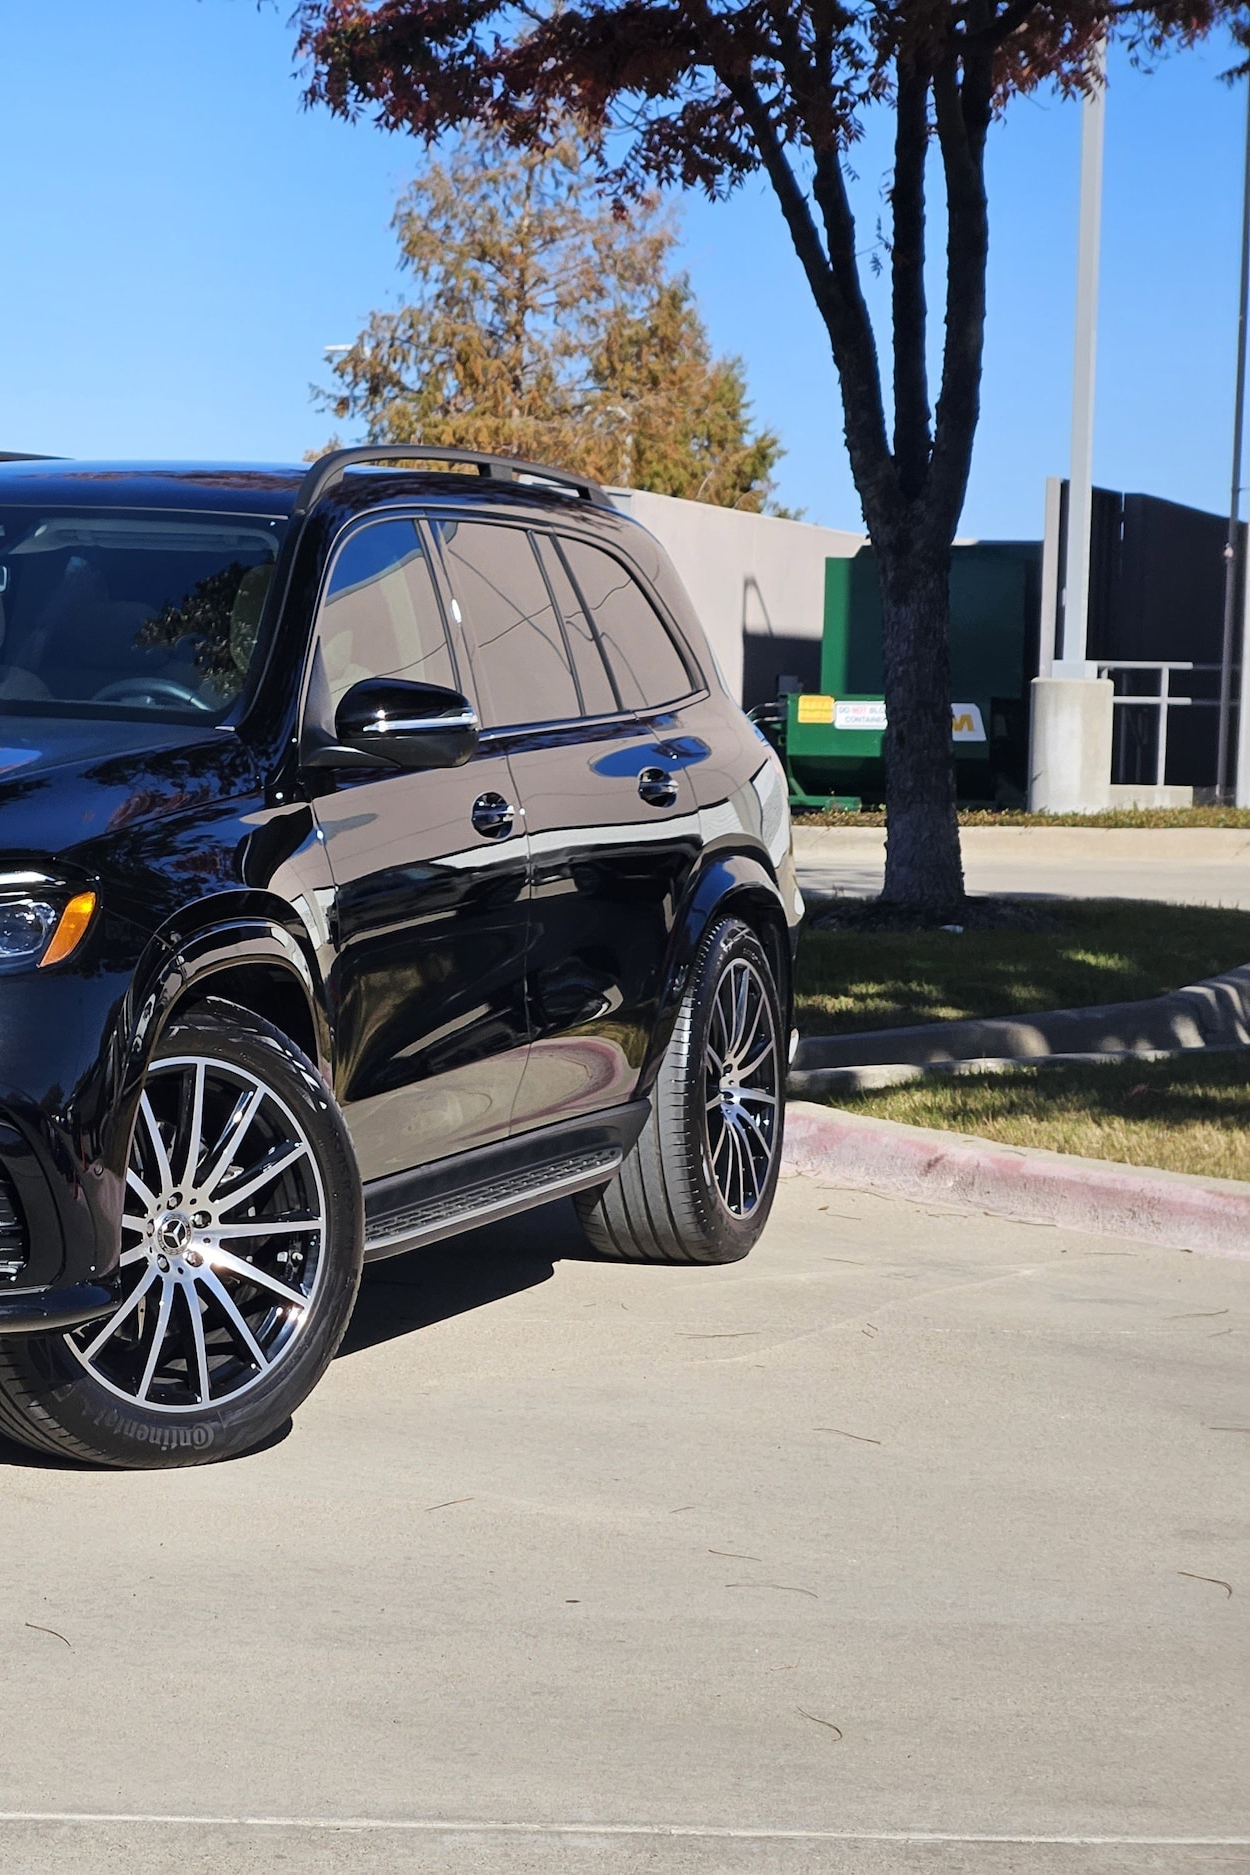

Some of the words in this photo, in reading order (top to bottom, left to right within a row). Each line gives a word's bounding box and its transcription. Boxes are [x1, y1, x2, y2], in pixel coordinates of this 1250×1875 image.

[838, 706, 851, 714] DO
[852, 706, 867, 714] NOT
[869, 706, 884, 714] BLO
[844, 715, 884, 723] CONTAINE
[93, 1408, 215, 1451] Continental
